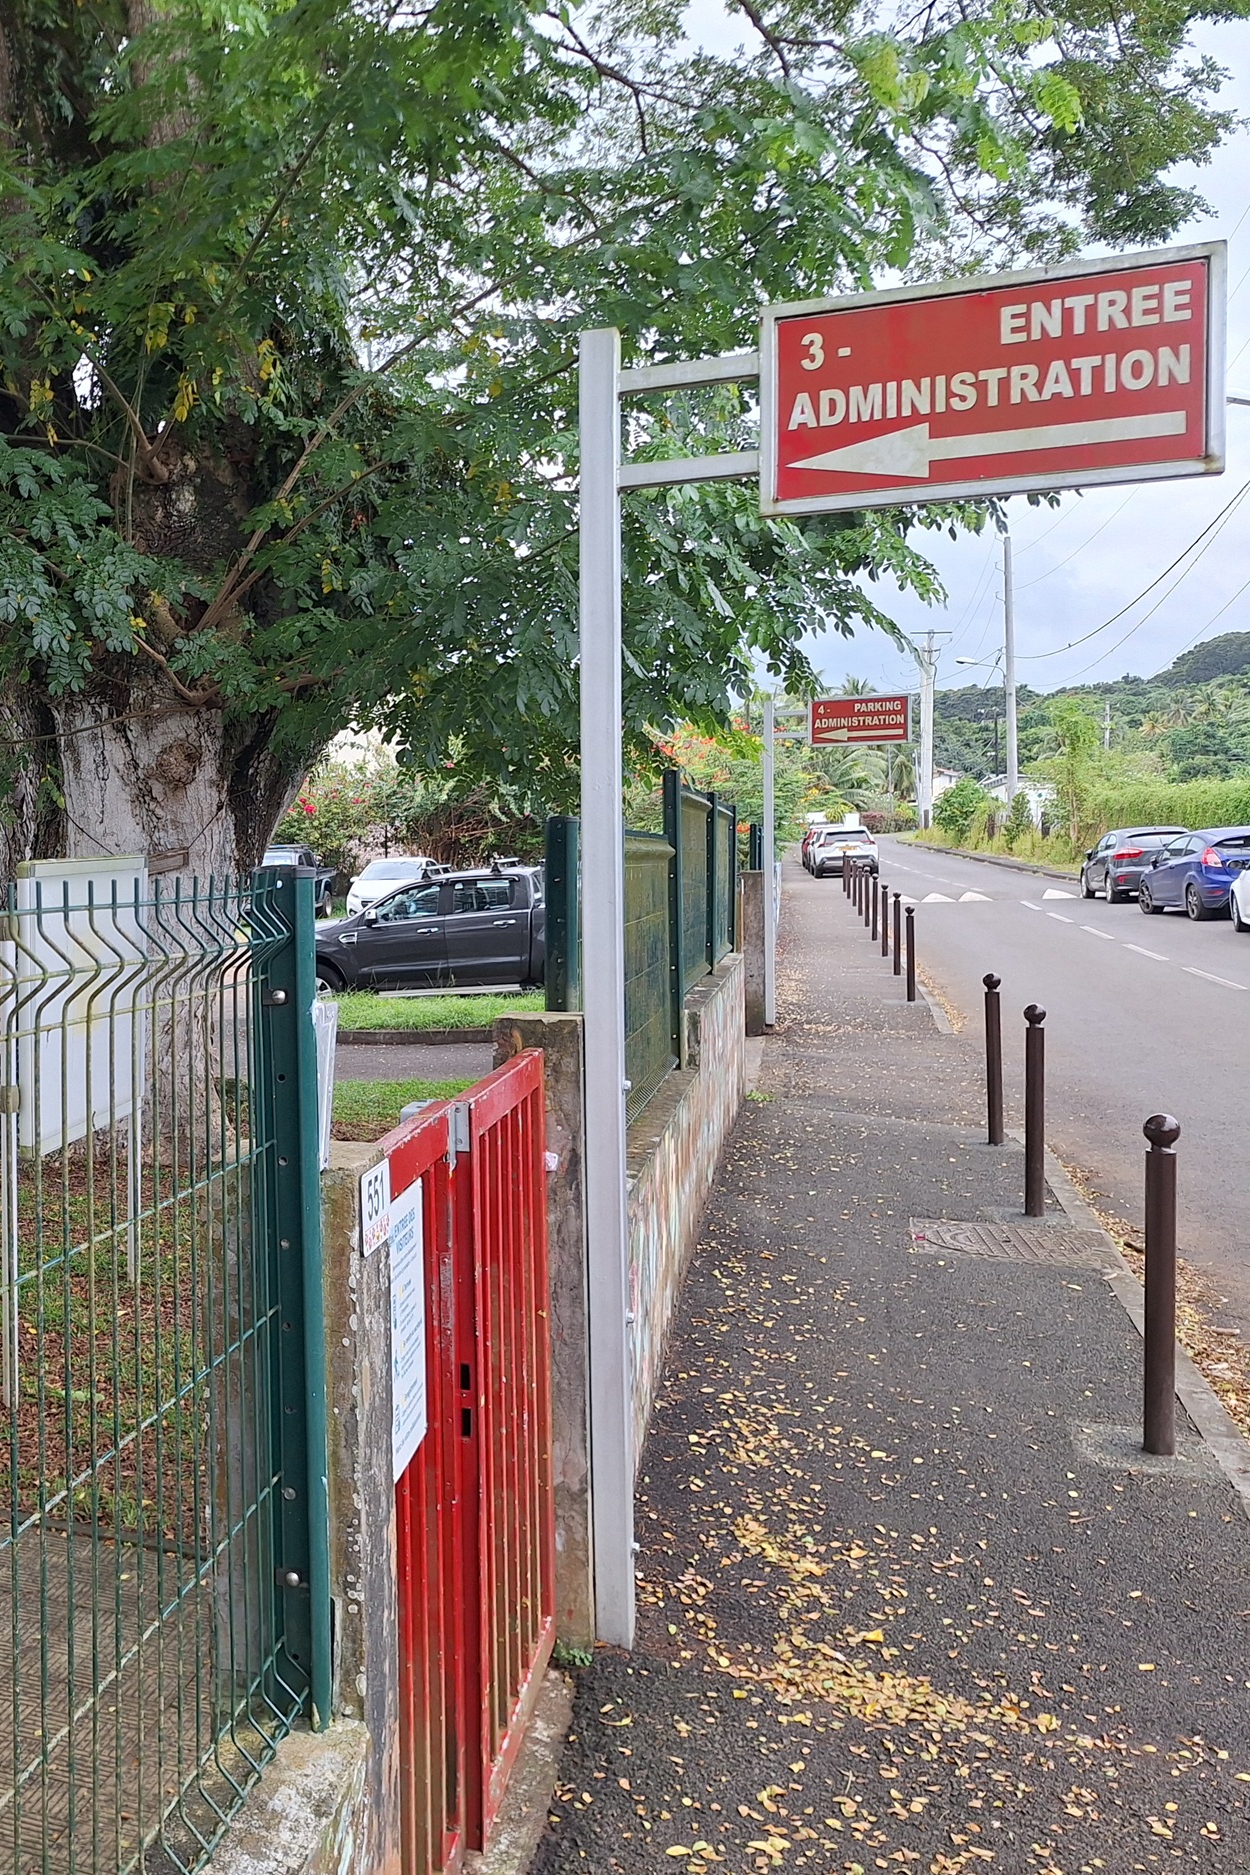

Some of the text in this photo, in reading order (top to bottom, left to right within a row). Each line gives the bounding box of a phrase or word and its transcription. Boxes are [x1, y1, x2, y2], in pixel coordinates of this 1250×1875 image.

[1000, 280, 1193, 345] ENTREE
[788, 343, 1191, 431] ADMINISTRATION
[814, 714, 904, 728] ADMINISTRATION
[854, 701, 901, 712] PARKING
[367, 1170, 385, 1222] 551
